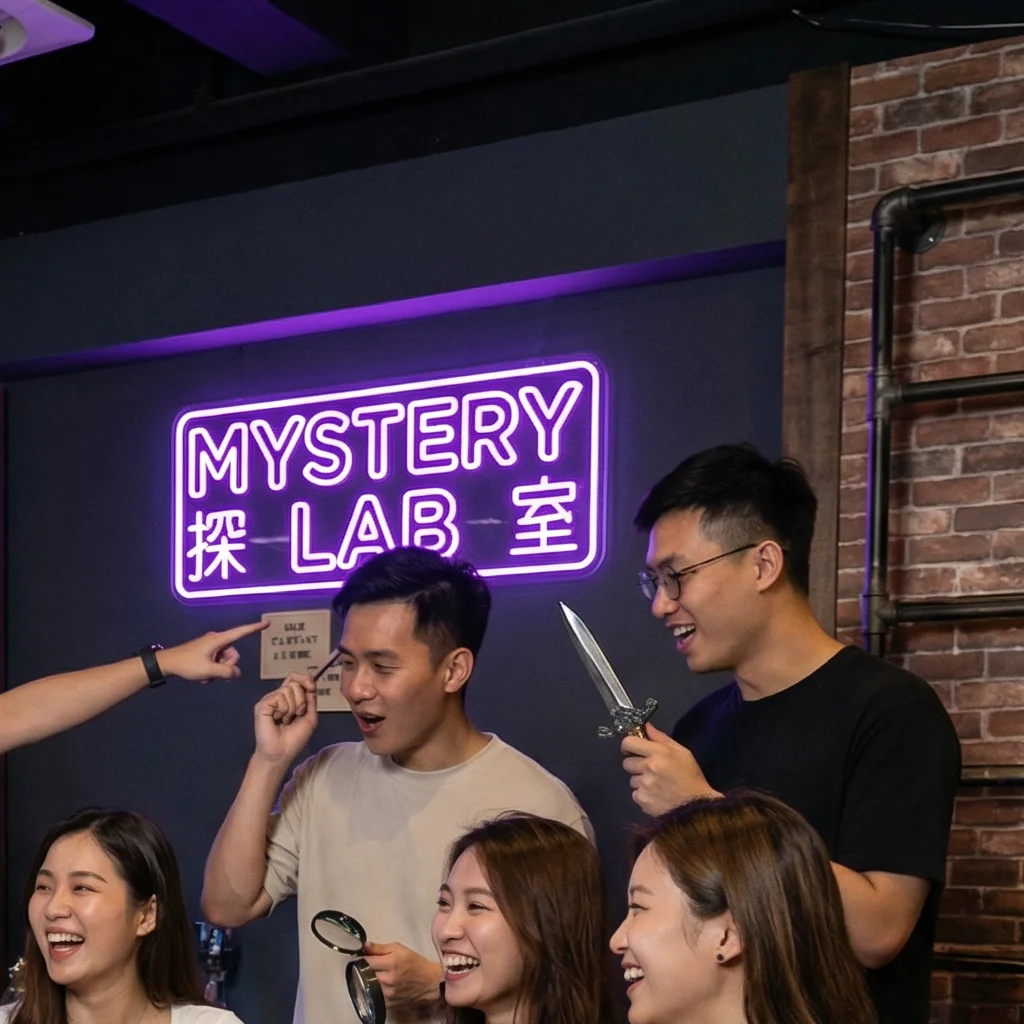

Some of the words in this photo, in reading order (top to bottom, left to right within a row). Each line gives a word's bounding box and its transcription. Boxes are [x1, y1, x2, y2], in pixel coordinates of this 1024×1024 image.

[188, 380, 583, 499] MYSTERY
[187, 510, 246, 582] 探
[290, 487, 460, 574] LAB
[510, 475, 578, 555] 室
